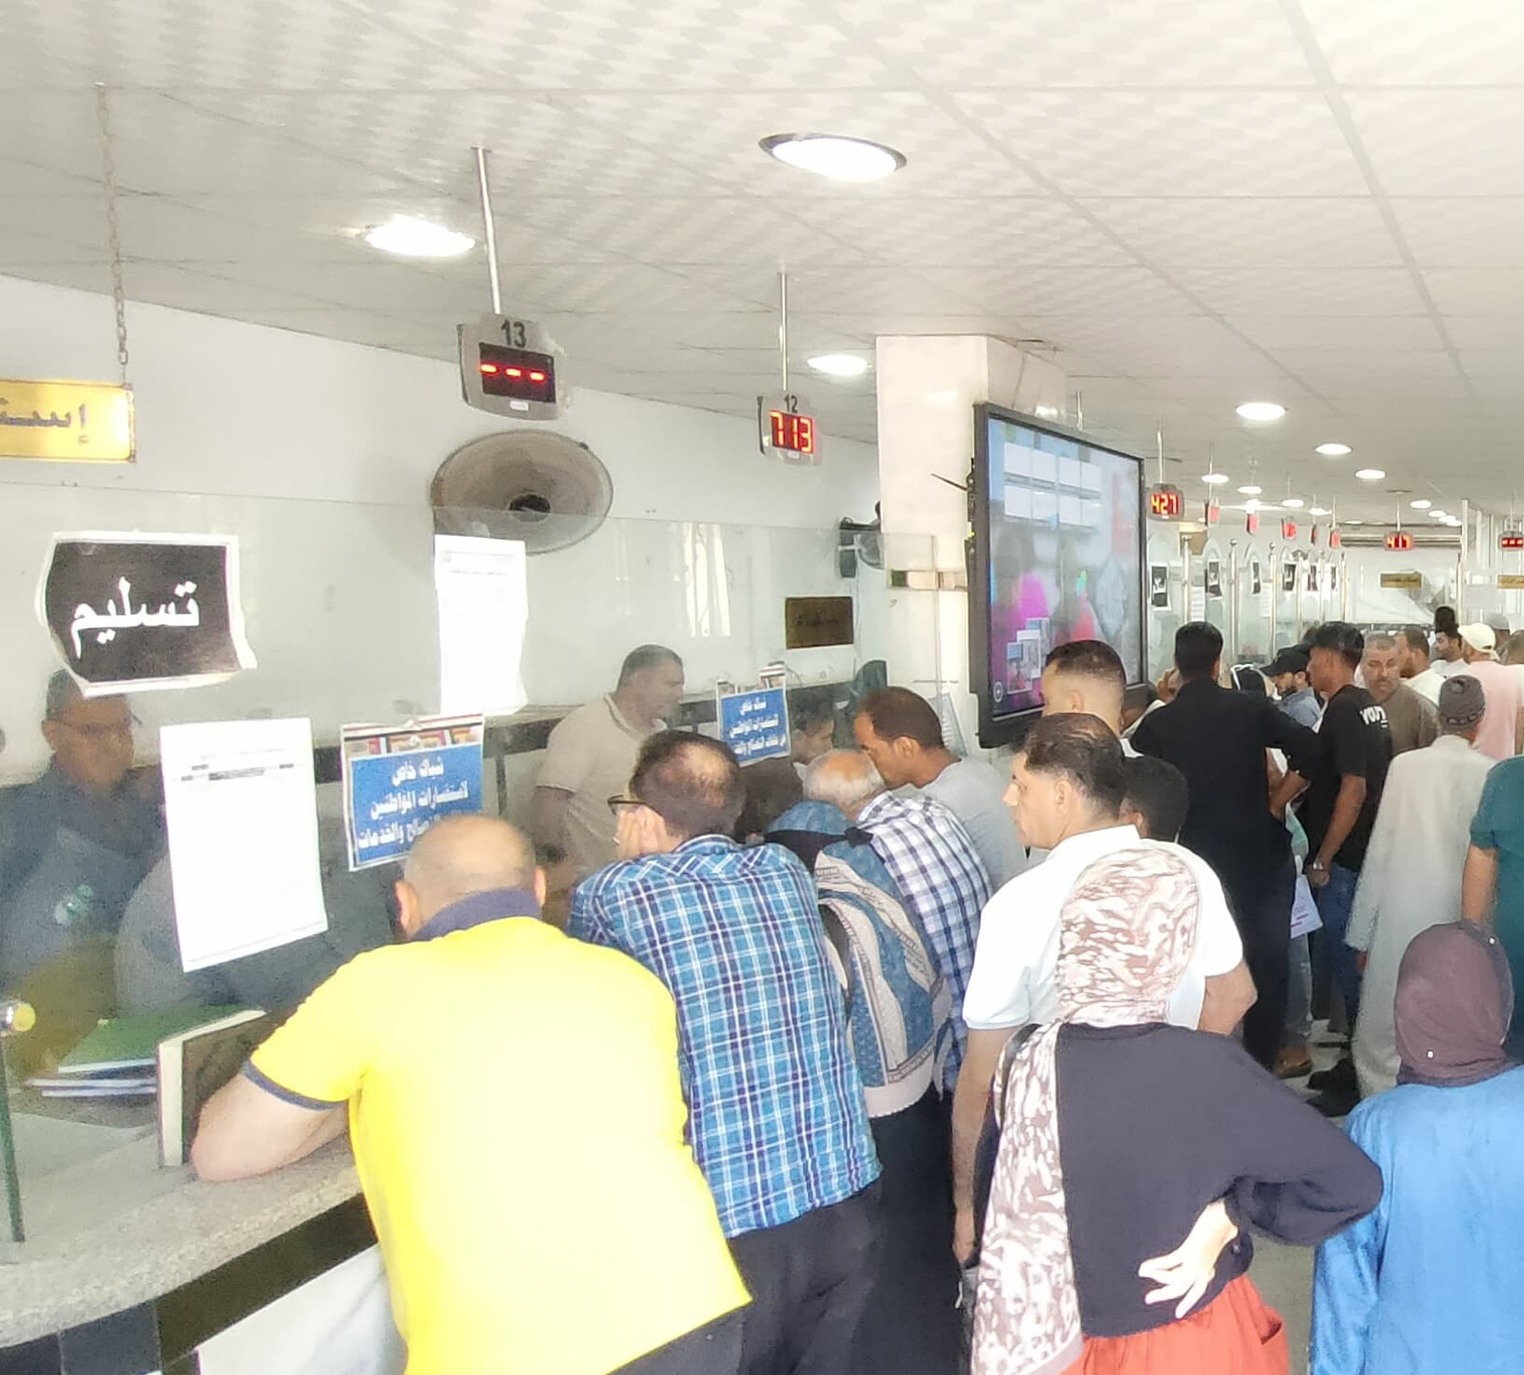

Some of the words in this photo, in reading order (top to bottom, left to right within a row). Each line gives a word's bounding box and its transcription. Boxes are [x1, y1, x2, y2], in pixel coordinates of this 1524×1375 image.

[501, 319, 527, 348] 13
[784, 394, 798, 413] 12
[769, 411, 812, 453] 713
[1151, 493, 1177, 515] 427
[70, 576, 200, 660] تسليم
